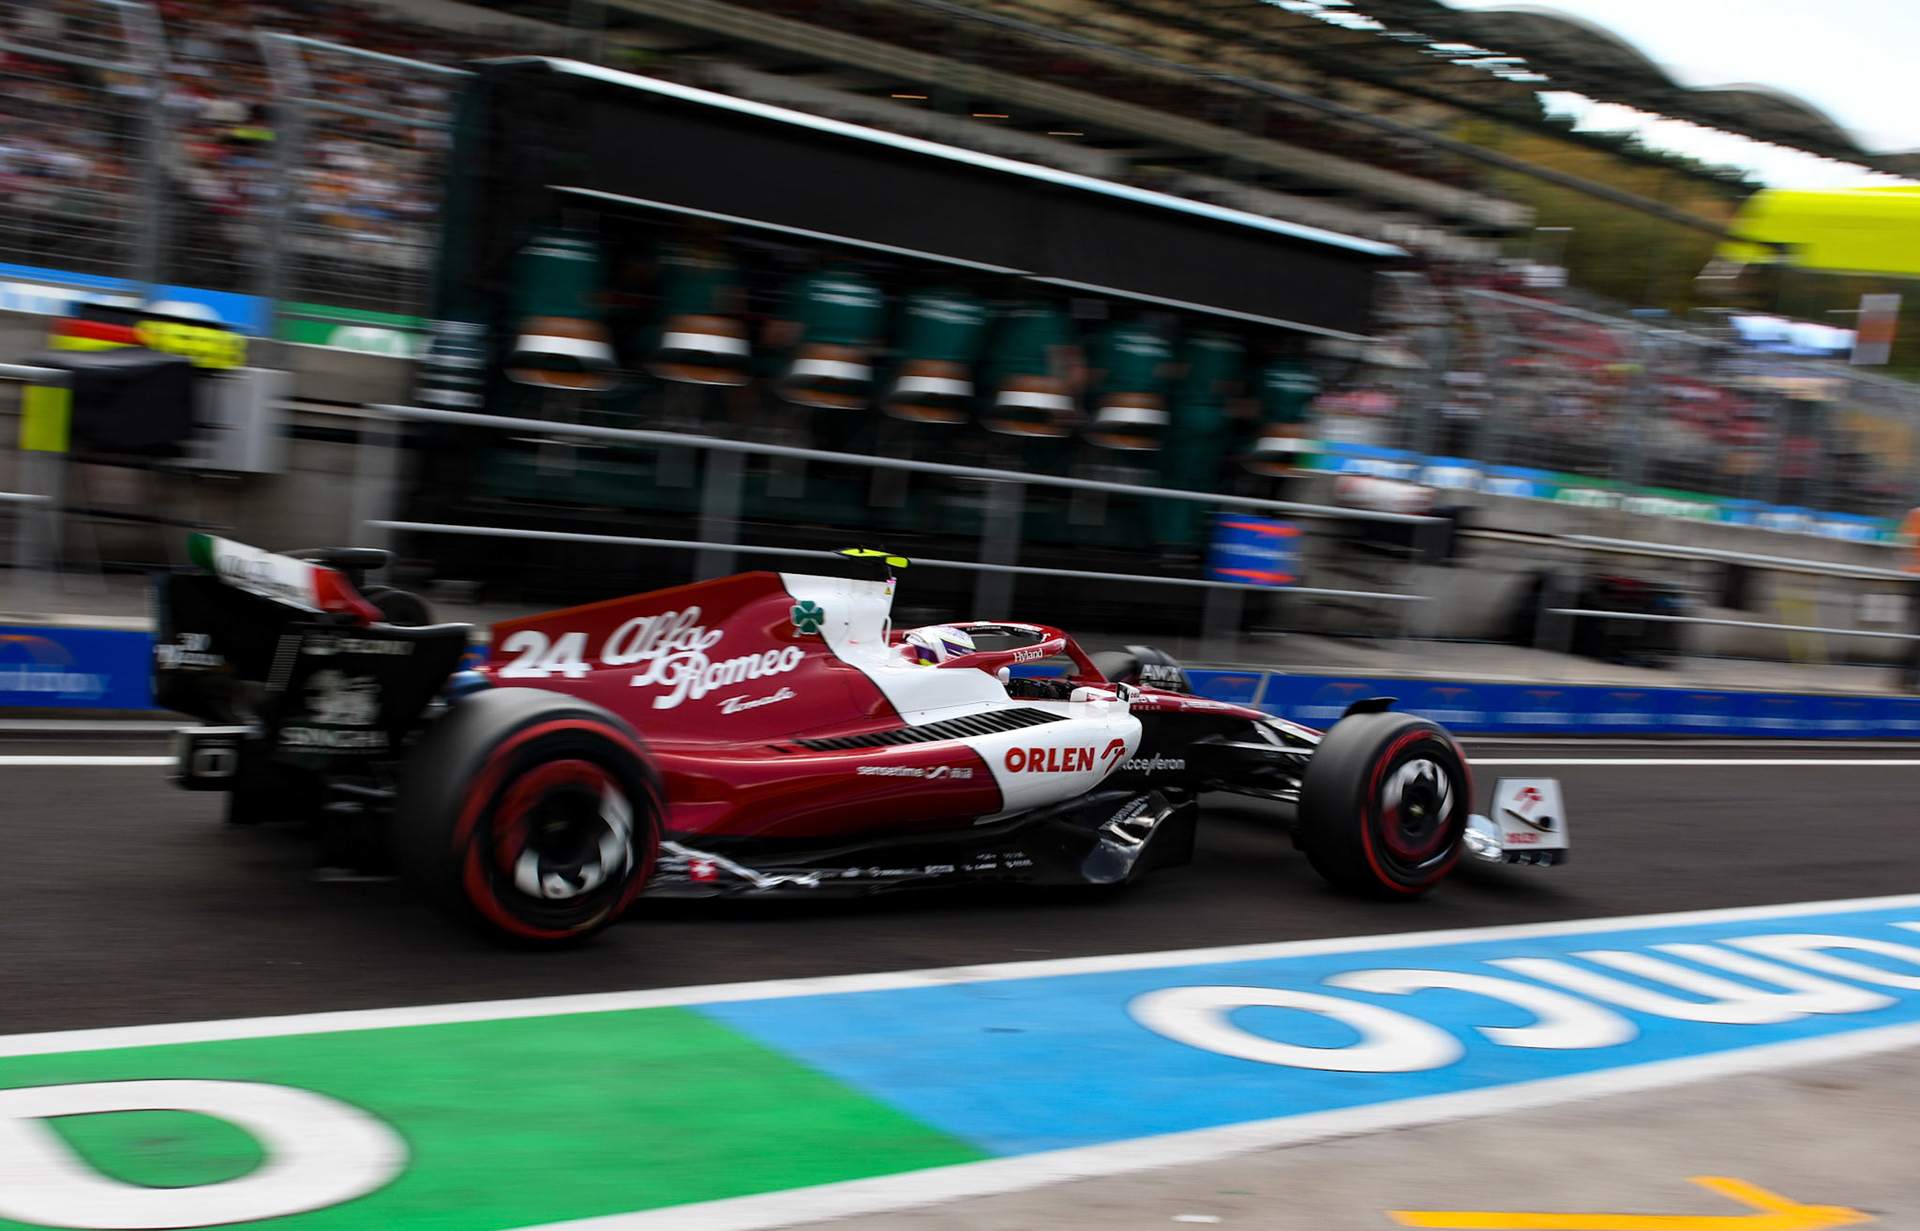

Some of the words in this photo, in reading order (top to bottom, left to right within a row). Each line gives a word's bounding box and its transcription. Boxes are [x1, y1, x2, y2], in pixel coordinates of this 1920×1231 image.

[501, 630, 593, 678] 24
[601, 606, 724, 666] Alfa
[1013, 648, 1043, 663] Hyland
[629, 645, 805, 709] Romeo
[856, 766, 925, 777] sensetime
[1004, 747, 1096, 773] ORLEN
